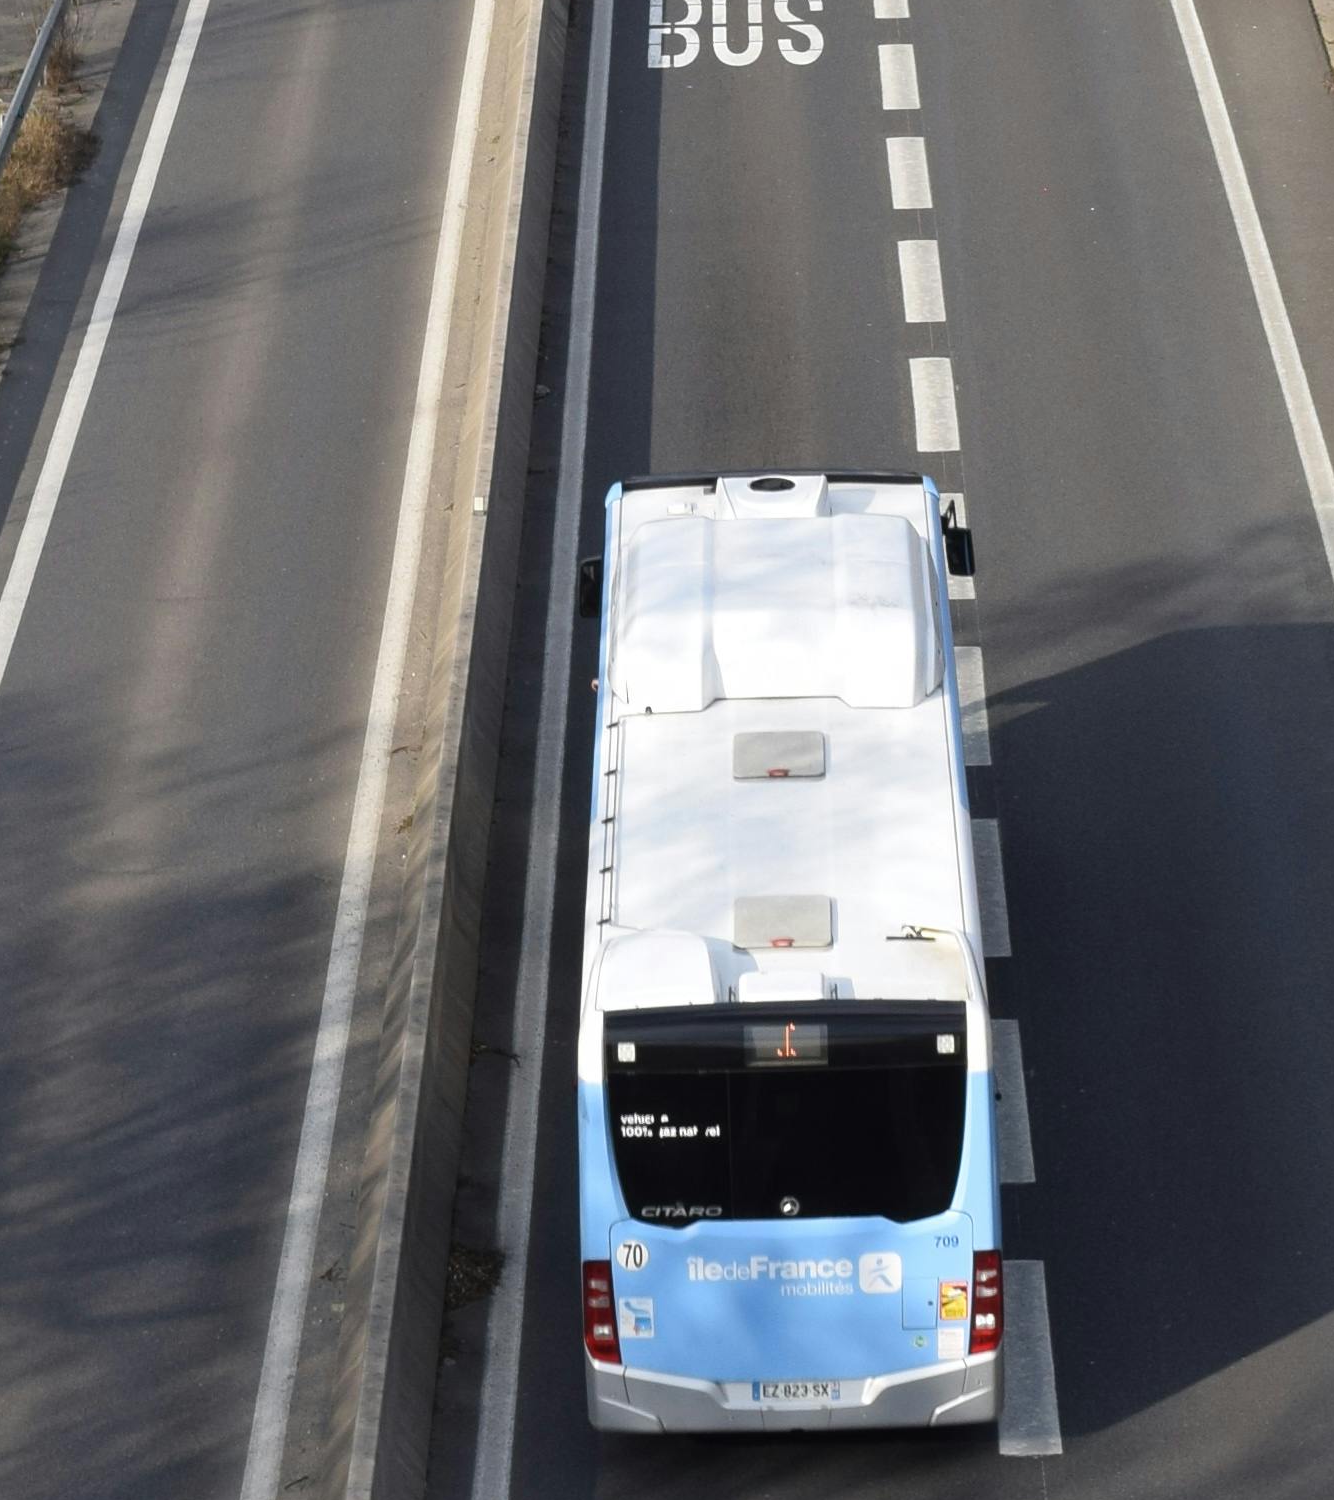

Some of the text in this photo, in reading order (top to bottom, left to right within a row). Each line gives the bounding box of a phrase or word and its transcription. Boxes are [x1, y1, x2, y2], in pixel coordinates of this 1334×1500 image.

[641, 1205, 723, 1218] CITARO
[933, 1235, 959, 1249] 709
[623, 1243, 643, 1269] 70
[781, 1280, 854, 1297] mobilités
